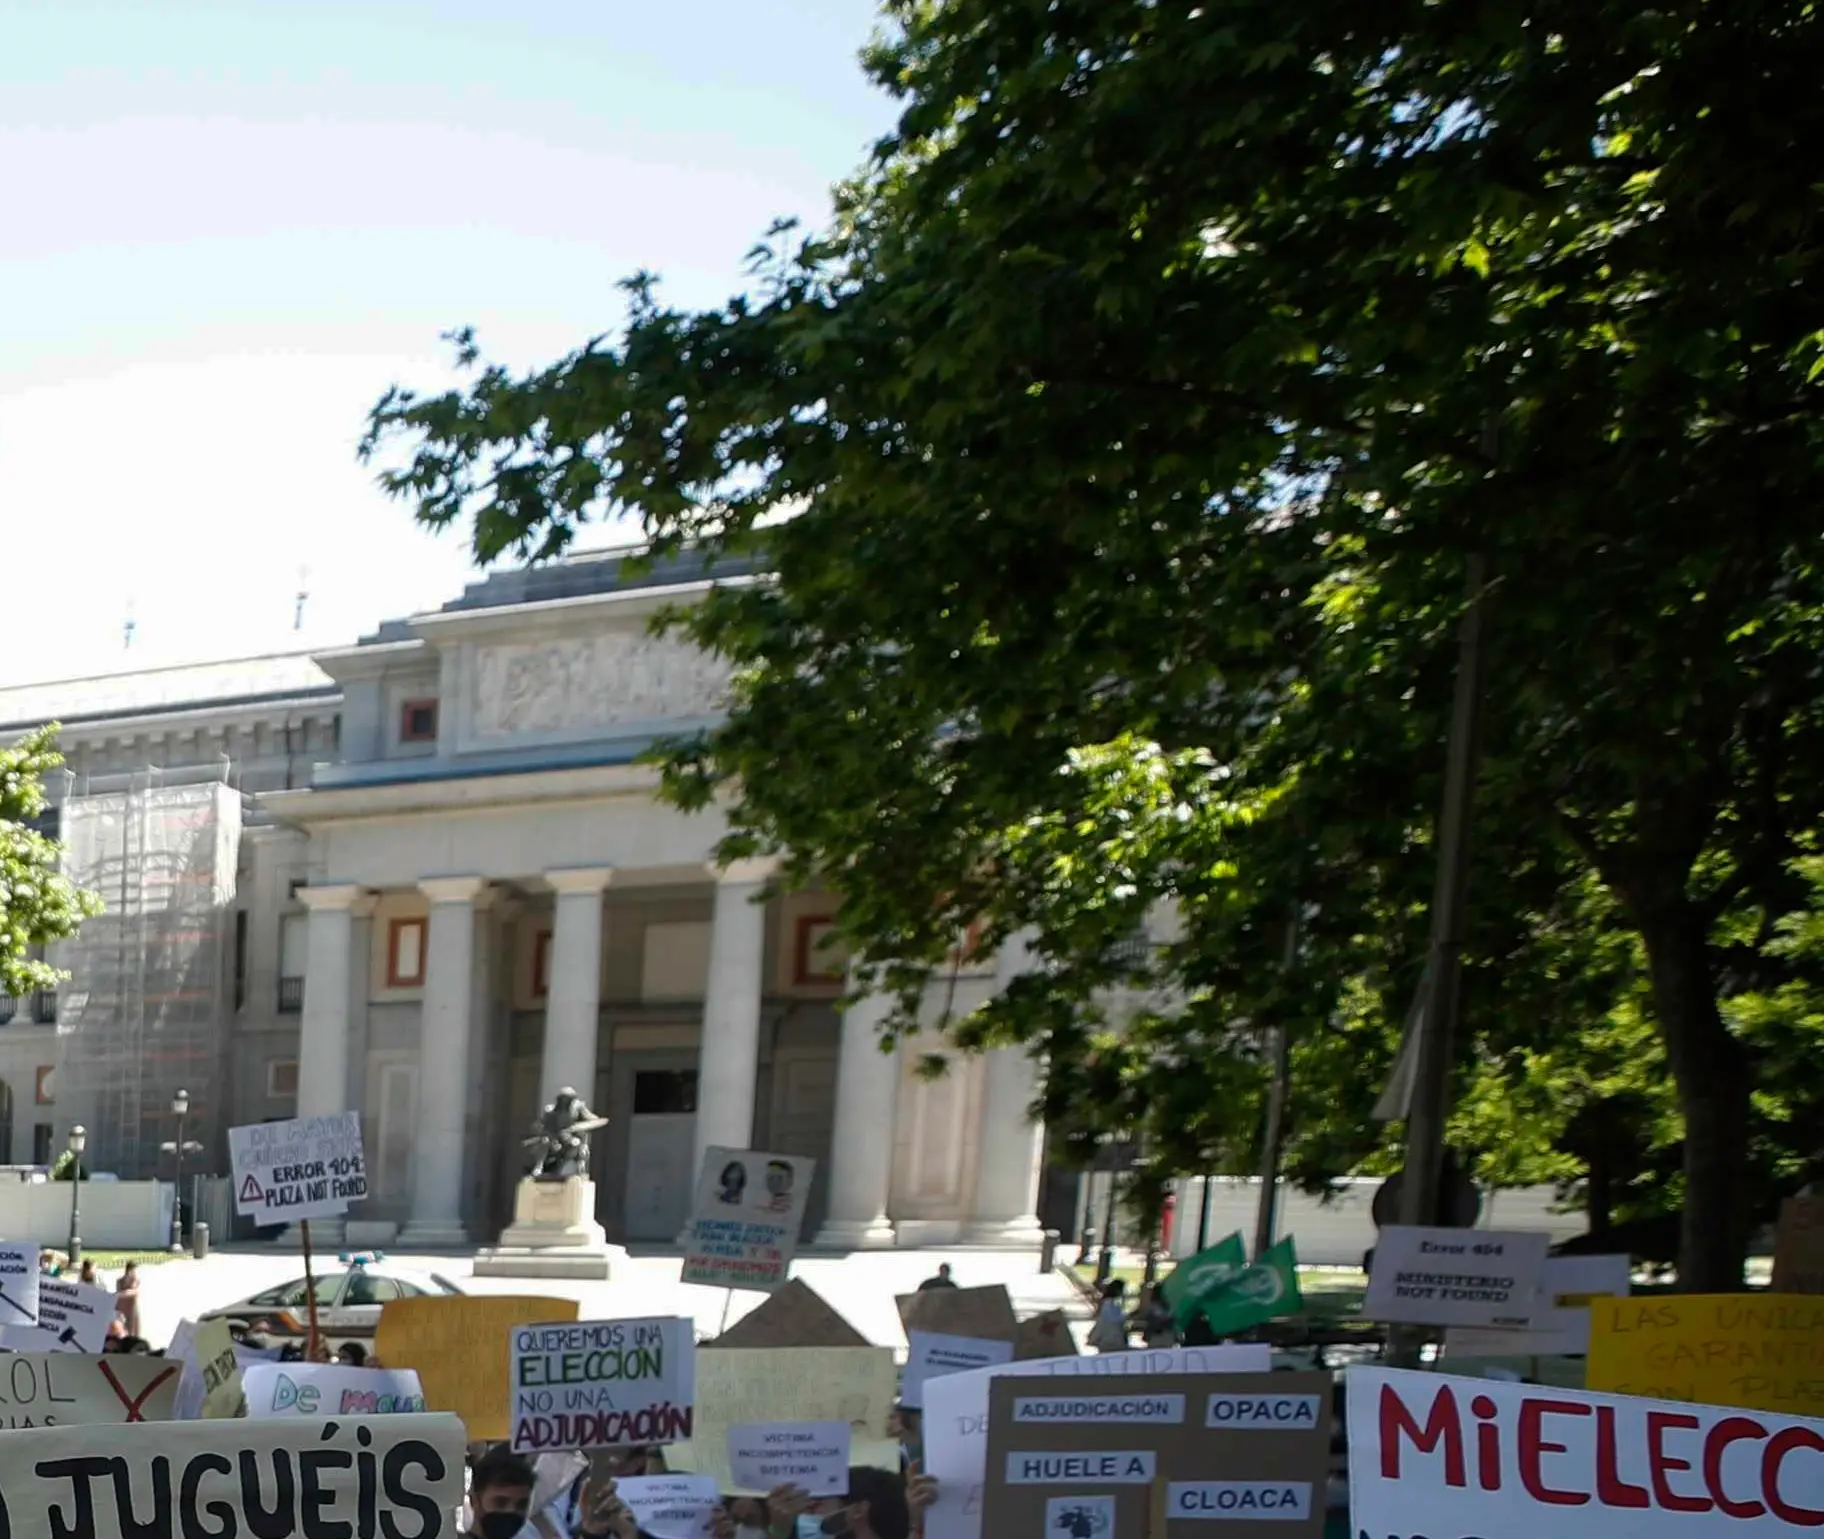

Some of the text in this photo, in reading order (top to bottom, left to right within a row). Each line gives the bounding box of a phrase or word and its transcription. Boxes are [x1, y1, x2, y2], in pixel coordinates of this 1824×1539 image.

[272, 1160, 326, 1184] ERROR
[265, 1183, 305, 1208] PLAZA
[306, 1180, 330, 1203] NOT
[1395, 1272, 1515, 1288] MINISTERIO
[517, 1323, 665, 1353] QUEREMOS UNA
[271, 1372, 322, 1413] De
[519, 1386, 615, 1414] NO UNA
[1019, 1399, 1314, 1422] ADJUDICACIÓN OPACA
[514, 1401, 694, 1450] ADJUDICACIÓN
[1379, 1382, 1498, 1492] MI
[1023, 1457, 1146, 1479] HUELE A
[1179, 1488, 1300, 1511] CLOACA
